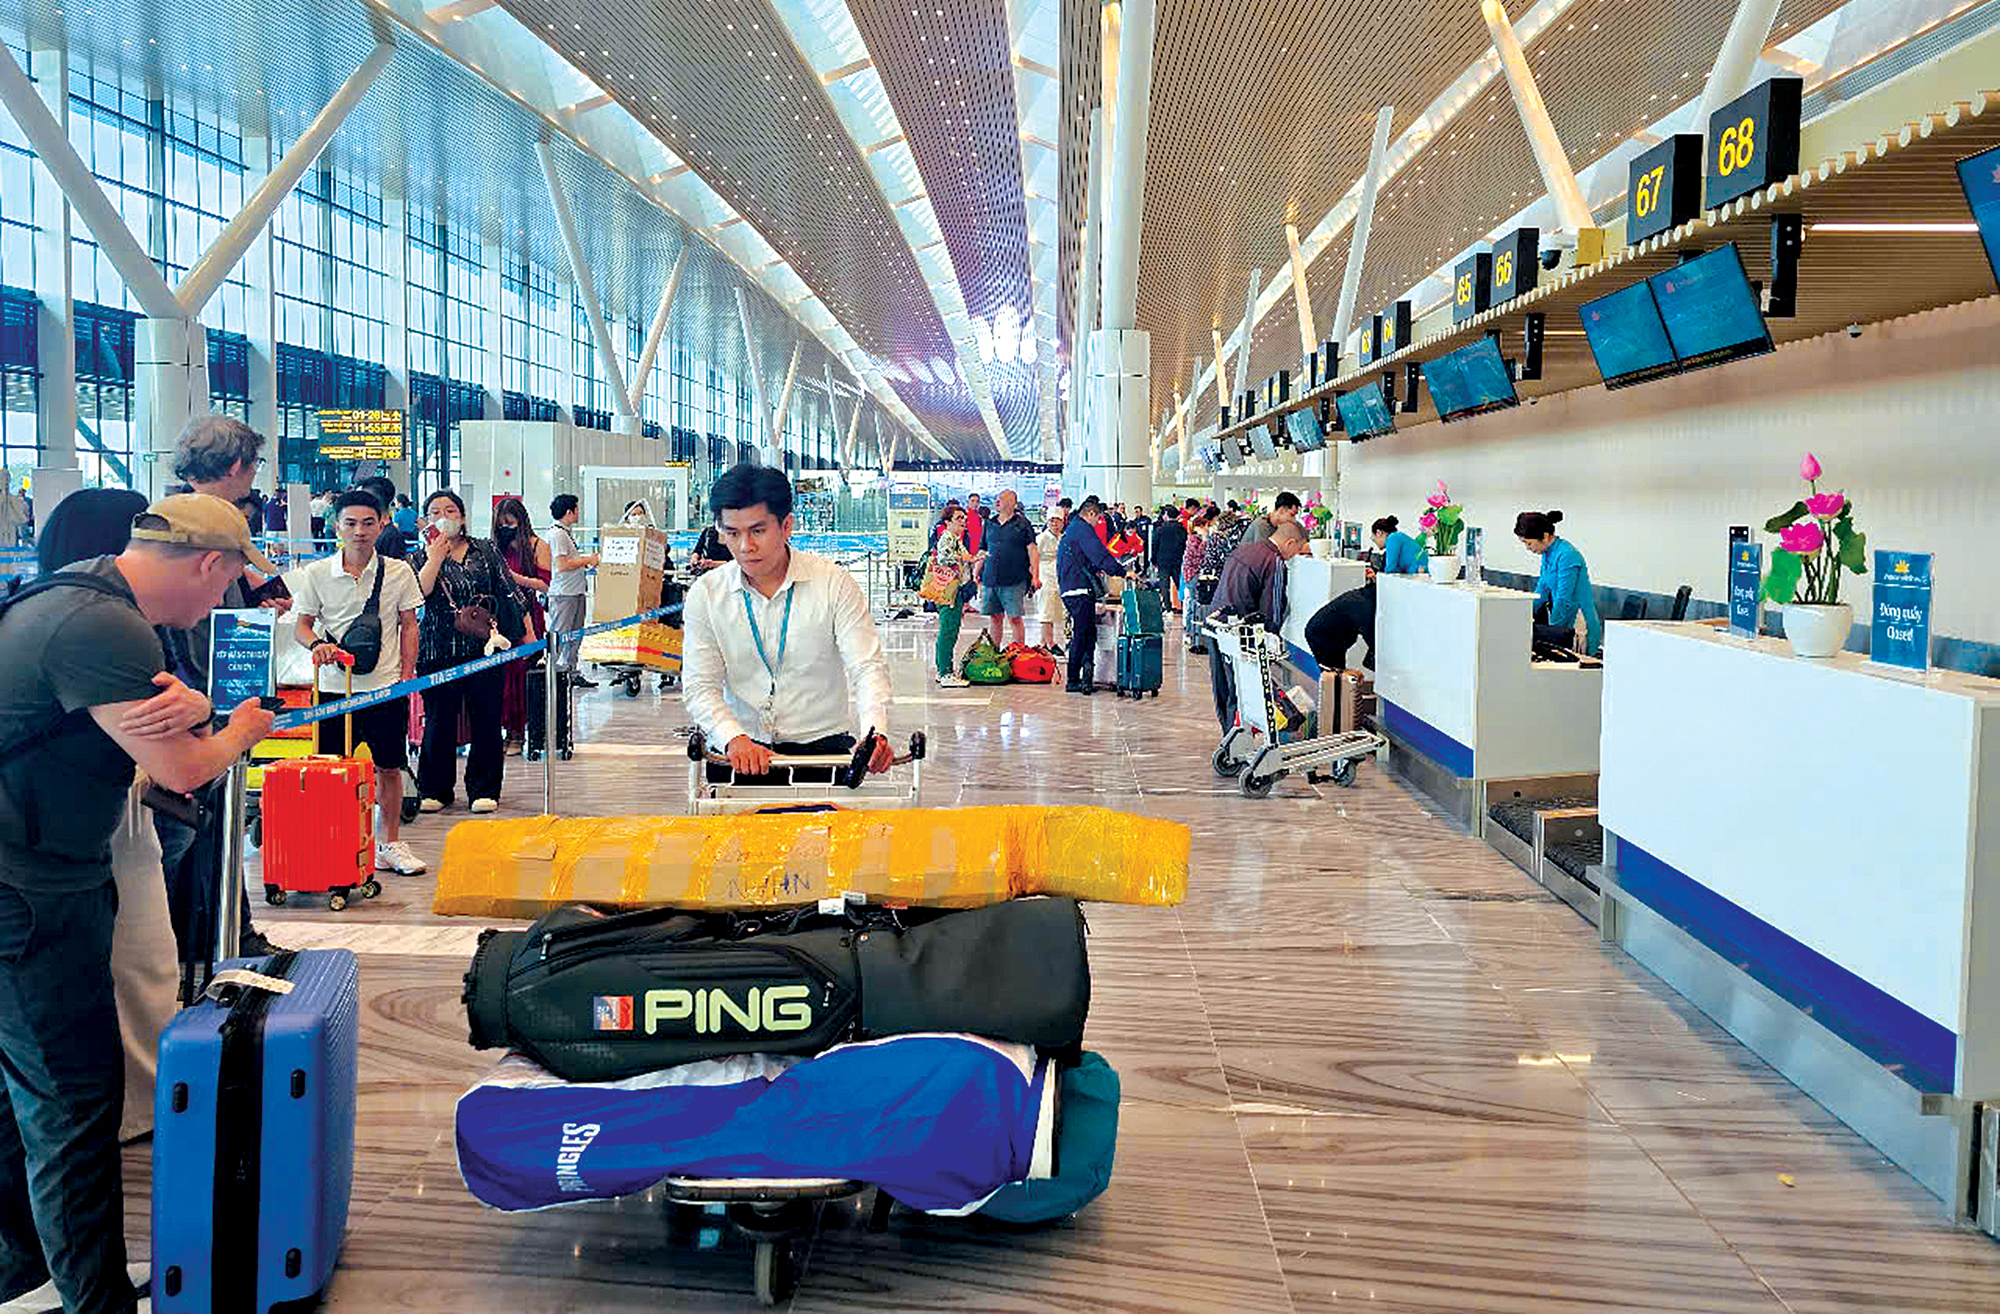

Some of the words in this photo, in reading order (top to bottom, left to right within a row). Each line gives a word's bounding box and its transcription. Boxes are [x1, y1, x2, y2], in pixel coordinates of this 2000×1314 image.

[1717, 117, 1755, 177] 68
[1636, 165, 1665, 218] 67
[1457, 272, 1472, 306] 65
[1496, 250, 1513, 287] 66
[645, 985, 812, 1035] PING
